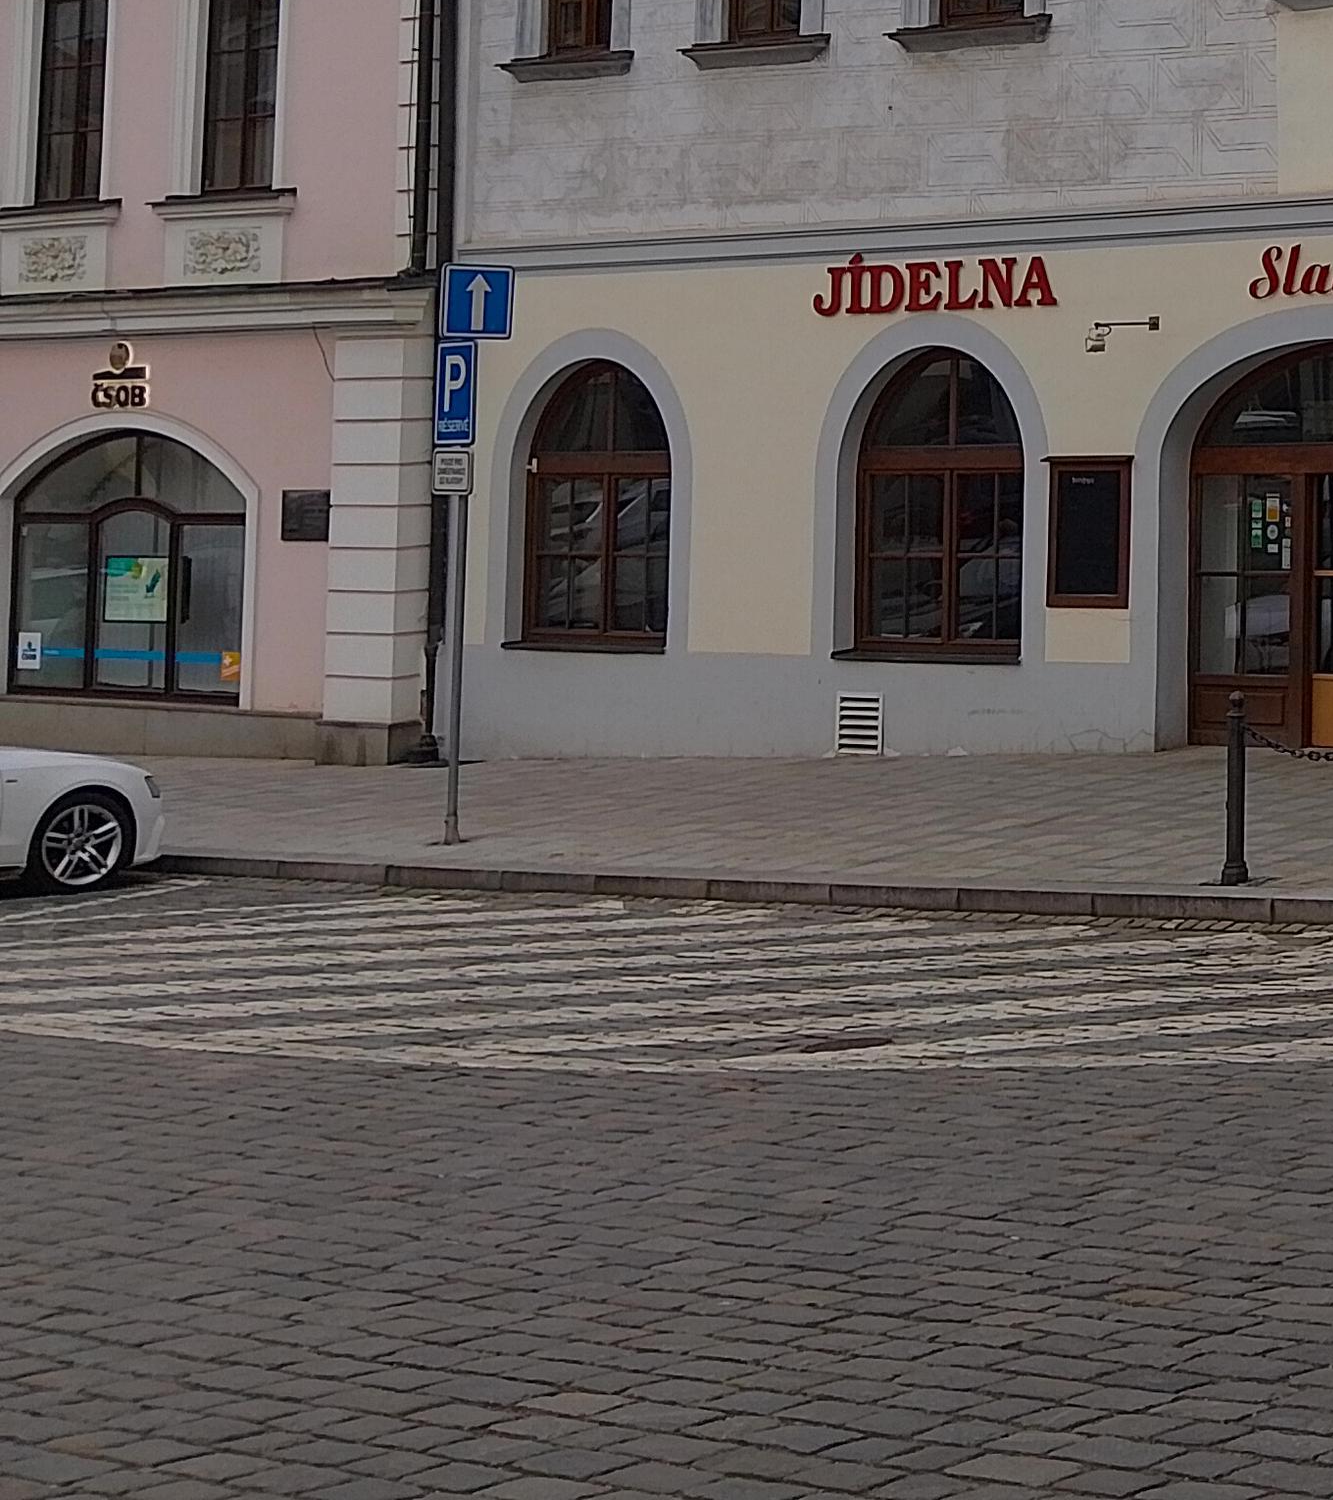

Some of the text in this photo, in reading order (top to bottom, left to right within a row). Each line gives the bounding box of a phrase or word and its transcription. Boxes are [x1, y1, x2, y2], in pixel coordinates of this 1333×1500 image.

[812, 252, 1058, 317] JÍDELNA
[91, 382, 147, 409] ČSOB
[443, 354, 466, 412] P
